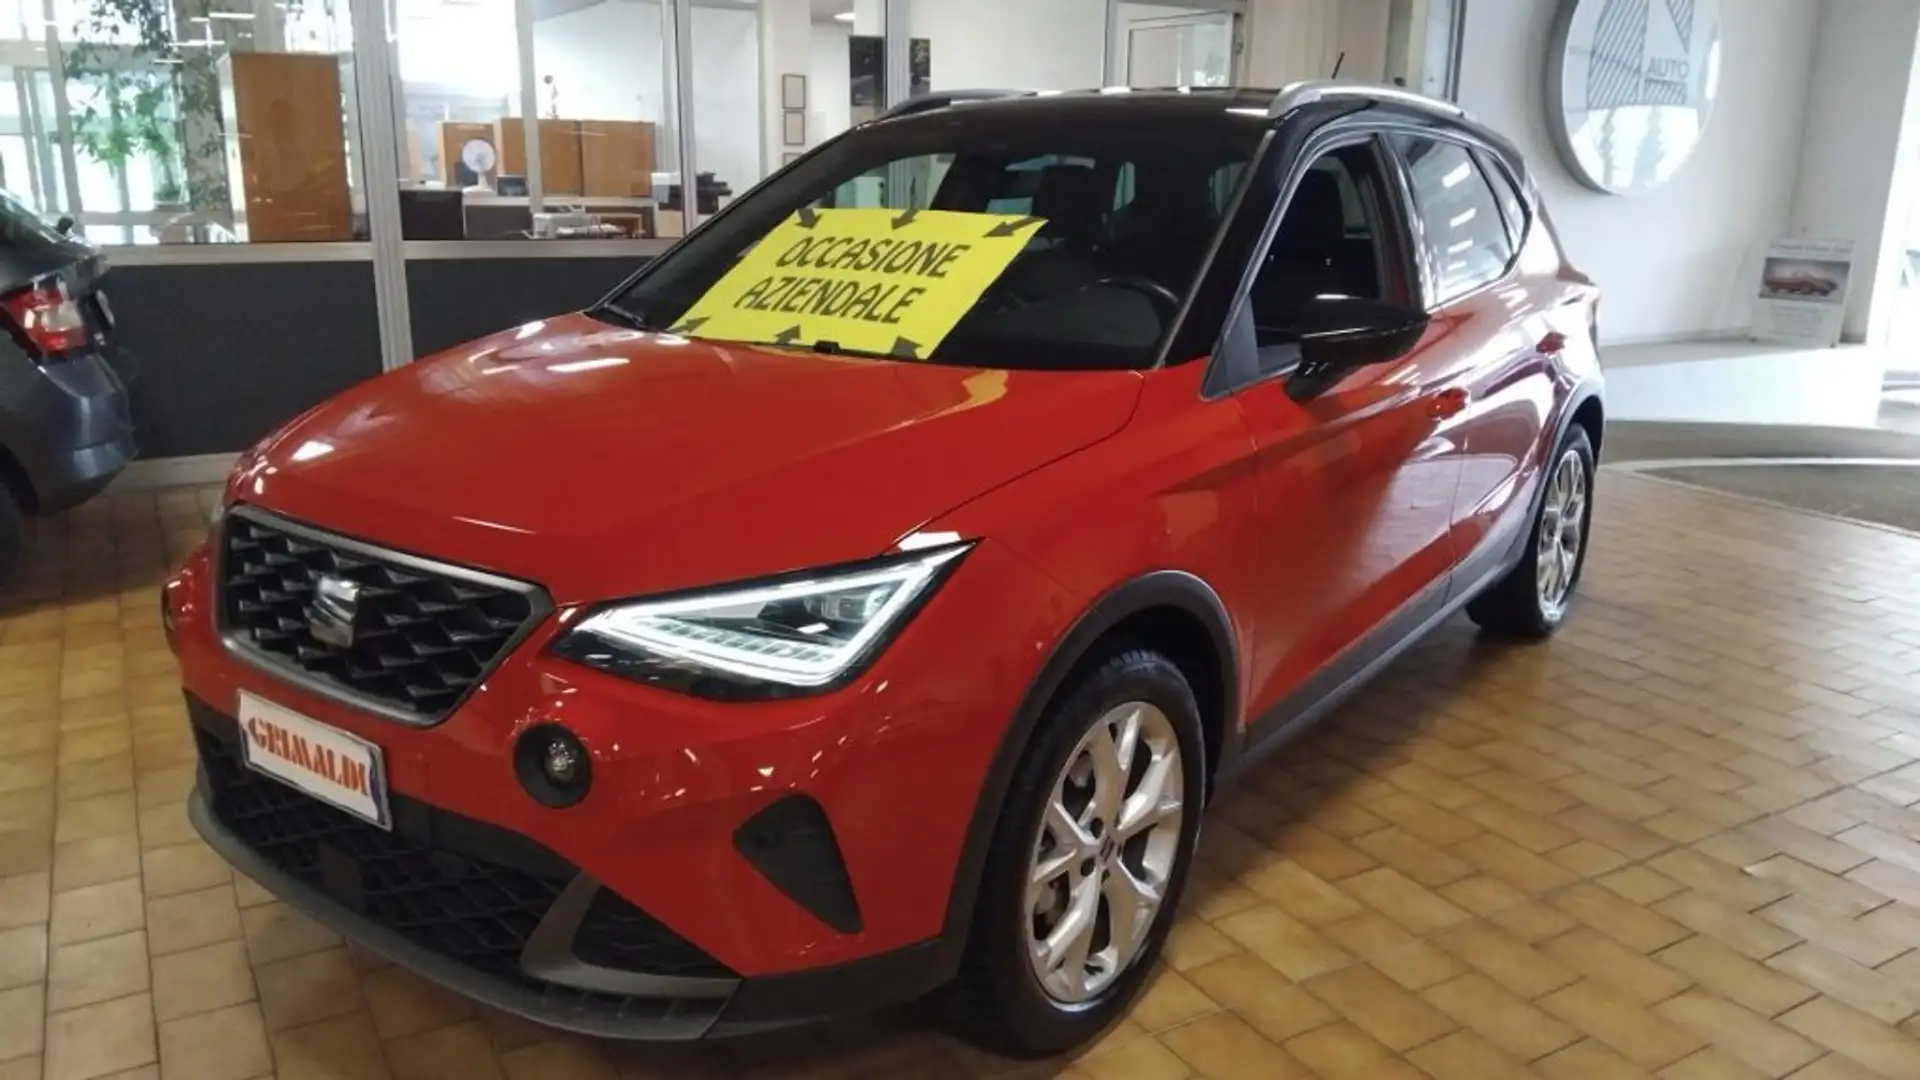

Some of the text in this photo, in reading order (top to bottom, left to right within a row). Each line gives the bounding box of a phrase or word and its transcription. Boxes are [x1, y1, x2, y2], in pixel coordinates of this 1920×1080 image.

[775, 236, 971, 278] OCCASIONE
[733, 276, 926, 324] AZIENDALE
[248, 717, 369, 796] GRIMALDI
